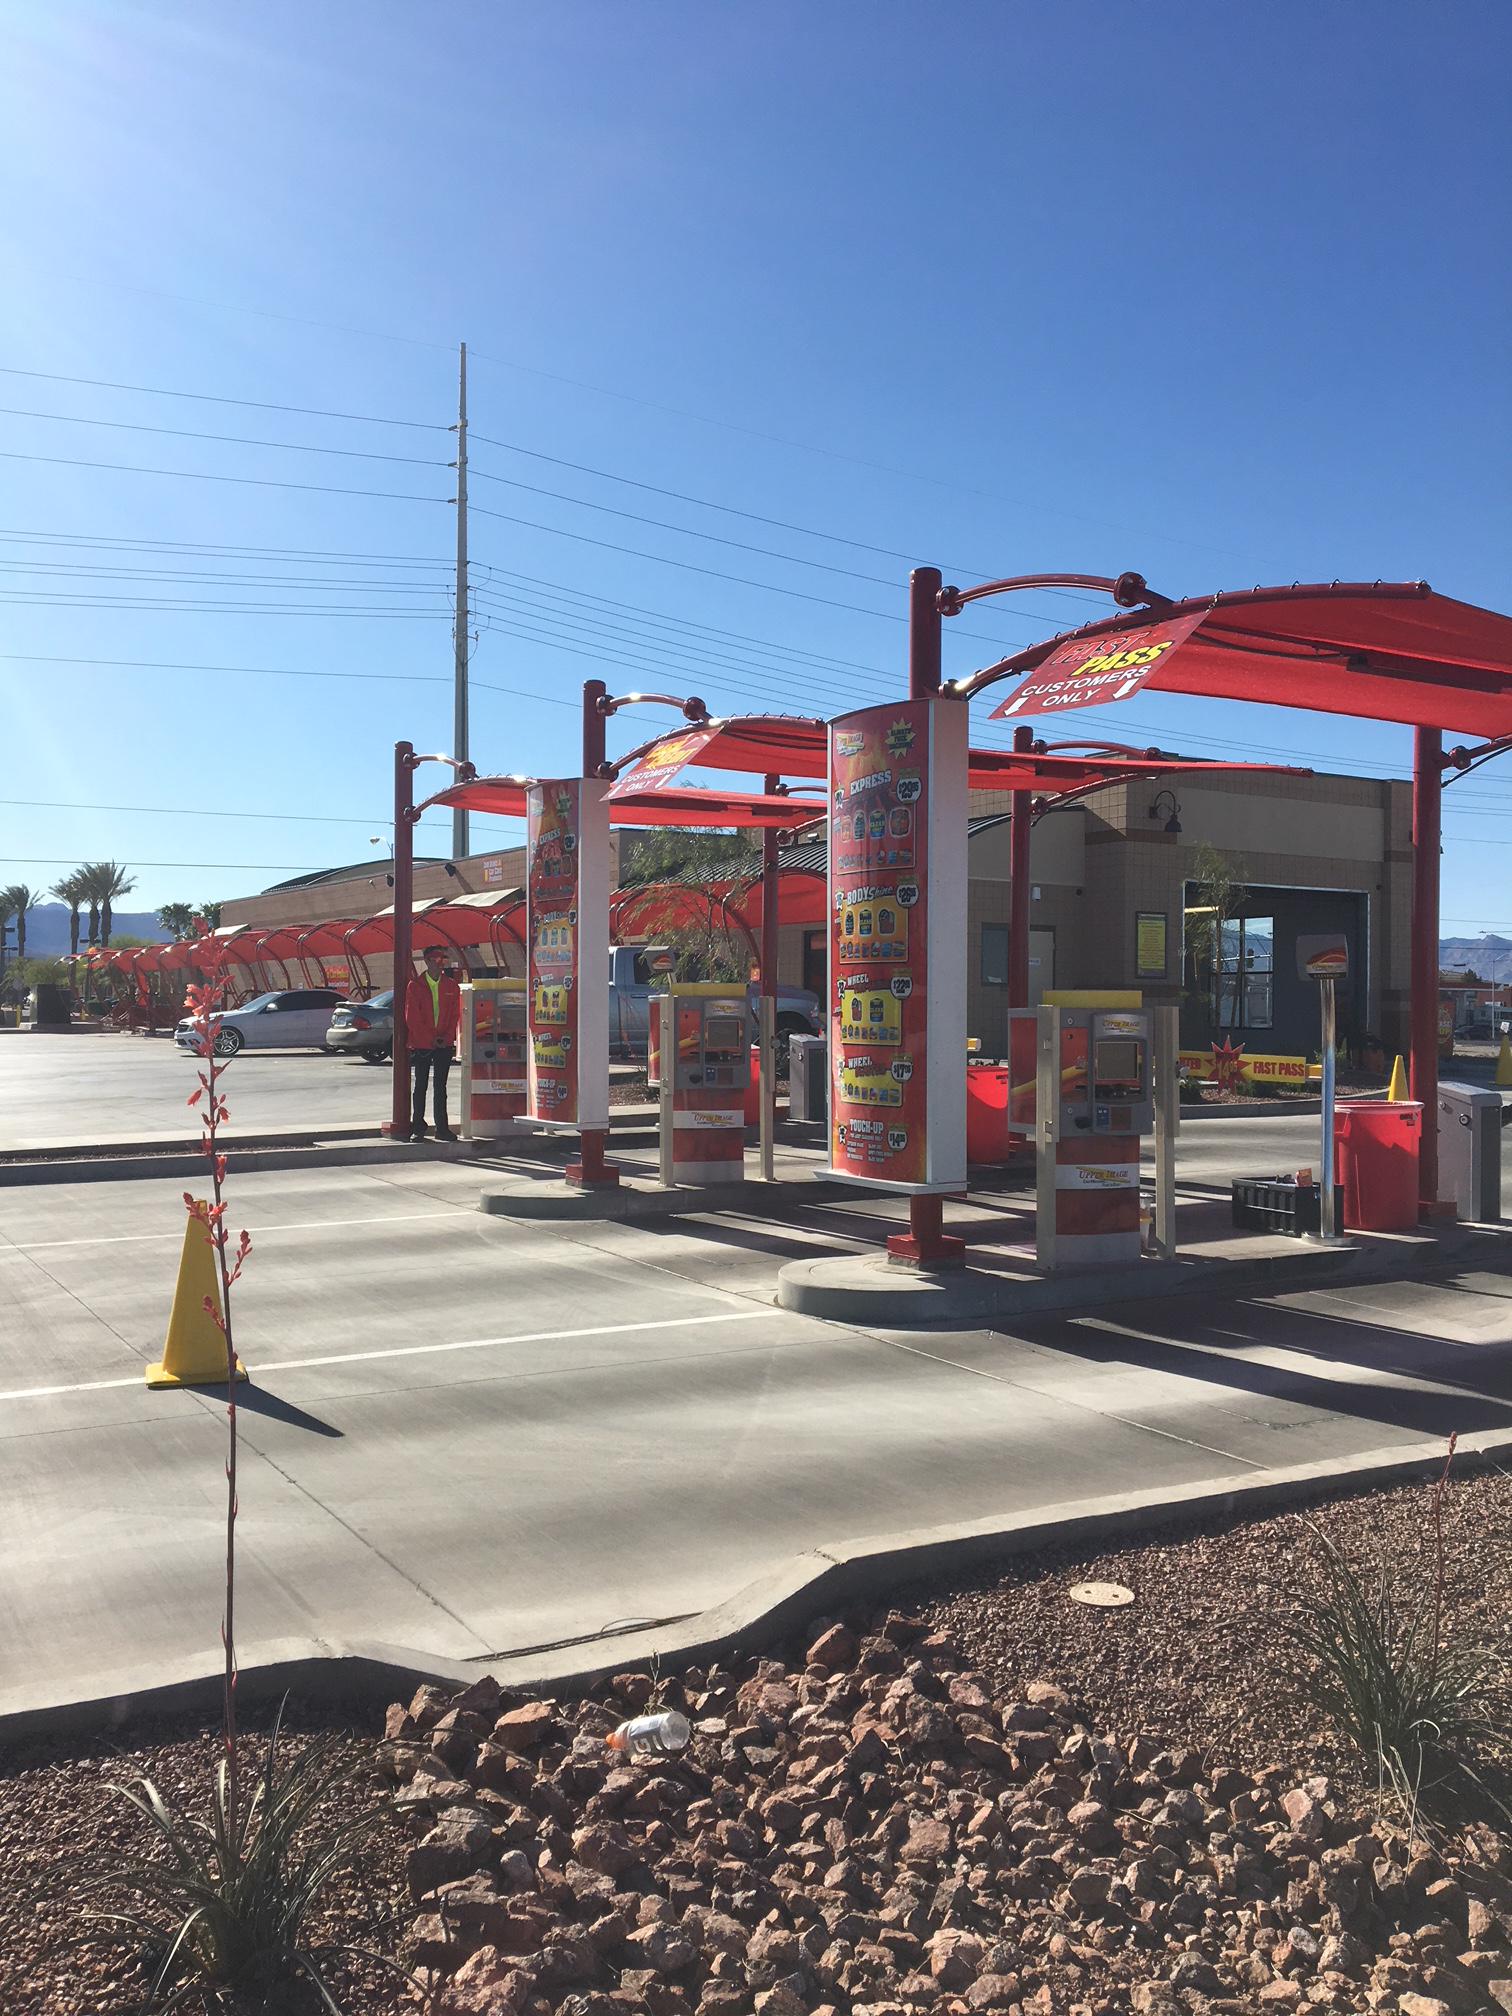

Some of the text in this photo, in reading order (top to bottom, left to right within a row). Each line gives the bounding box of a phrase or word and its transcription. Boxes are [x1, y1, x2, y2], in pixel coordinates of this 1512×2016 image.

[1052, 632, 1150, 664] FAST
[1071, 641, 1173, 676] PASS
[1021, 665, 1152, 696] CUSTOMERS
[1042, 688, 1102, 707] ONLY
[622, 765, 681, 783] CUSTOMERS
[850, 770, 892, 795] EXPRESS
[625, 780, 653, 792] ONLY
[847, 974, 869, 986] WHEEL
[848, 1056, 872, 1069] WHEEL
[1254, 1061, 1305, 1077] FAST PASS
[850, 1119, 884, 1134] TOUCH-UP
